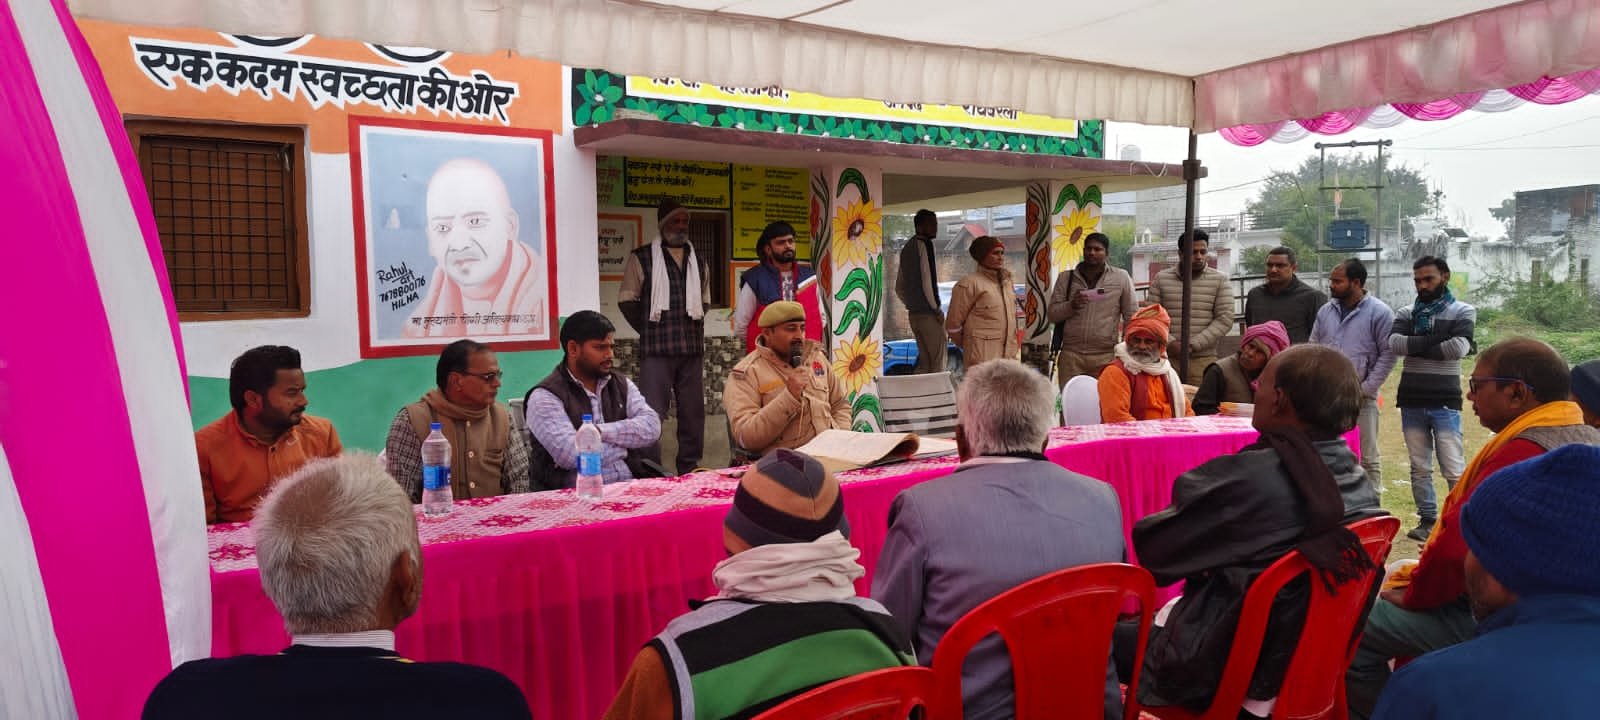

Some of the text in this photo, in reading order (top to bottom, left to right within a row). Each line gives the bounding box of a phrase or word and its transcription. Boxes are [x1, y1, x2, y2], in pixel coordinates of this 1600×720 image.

[213, 52, 299, 96] कदम
[300, 62, 419, 105] स्वच्छता
[376, 261, 408, 284] Rahul
